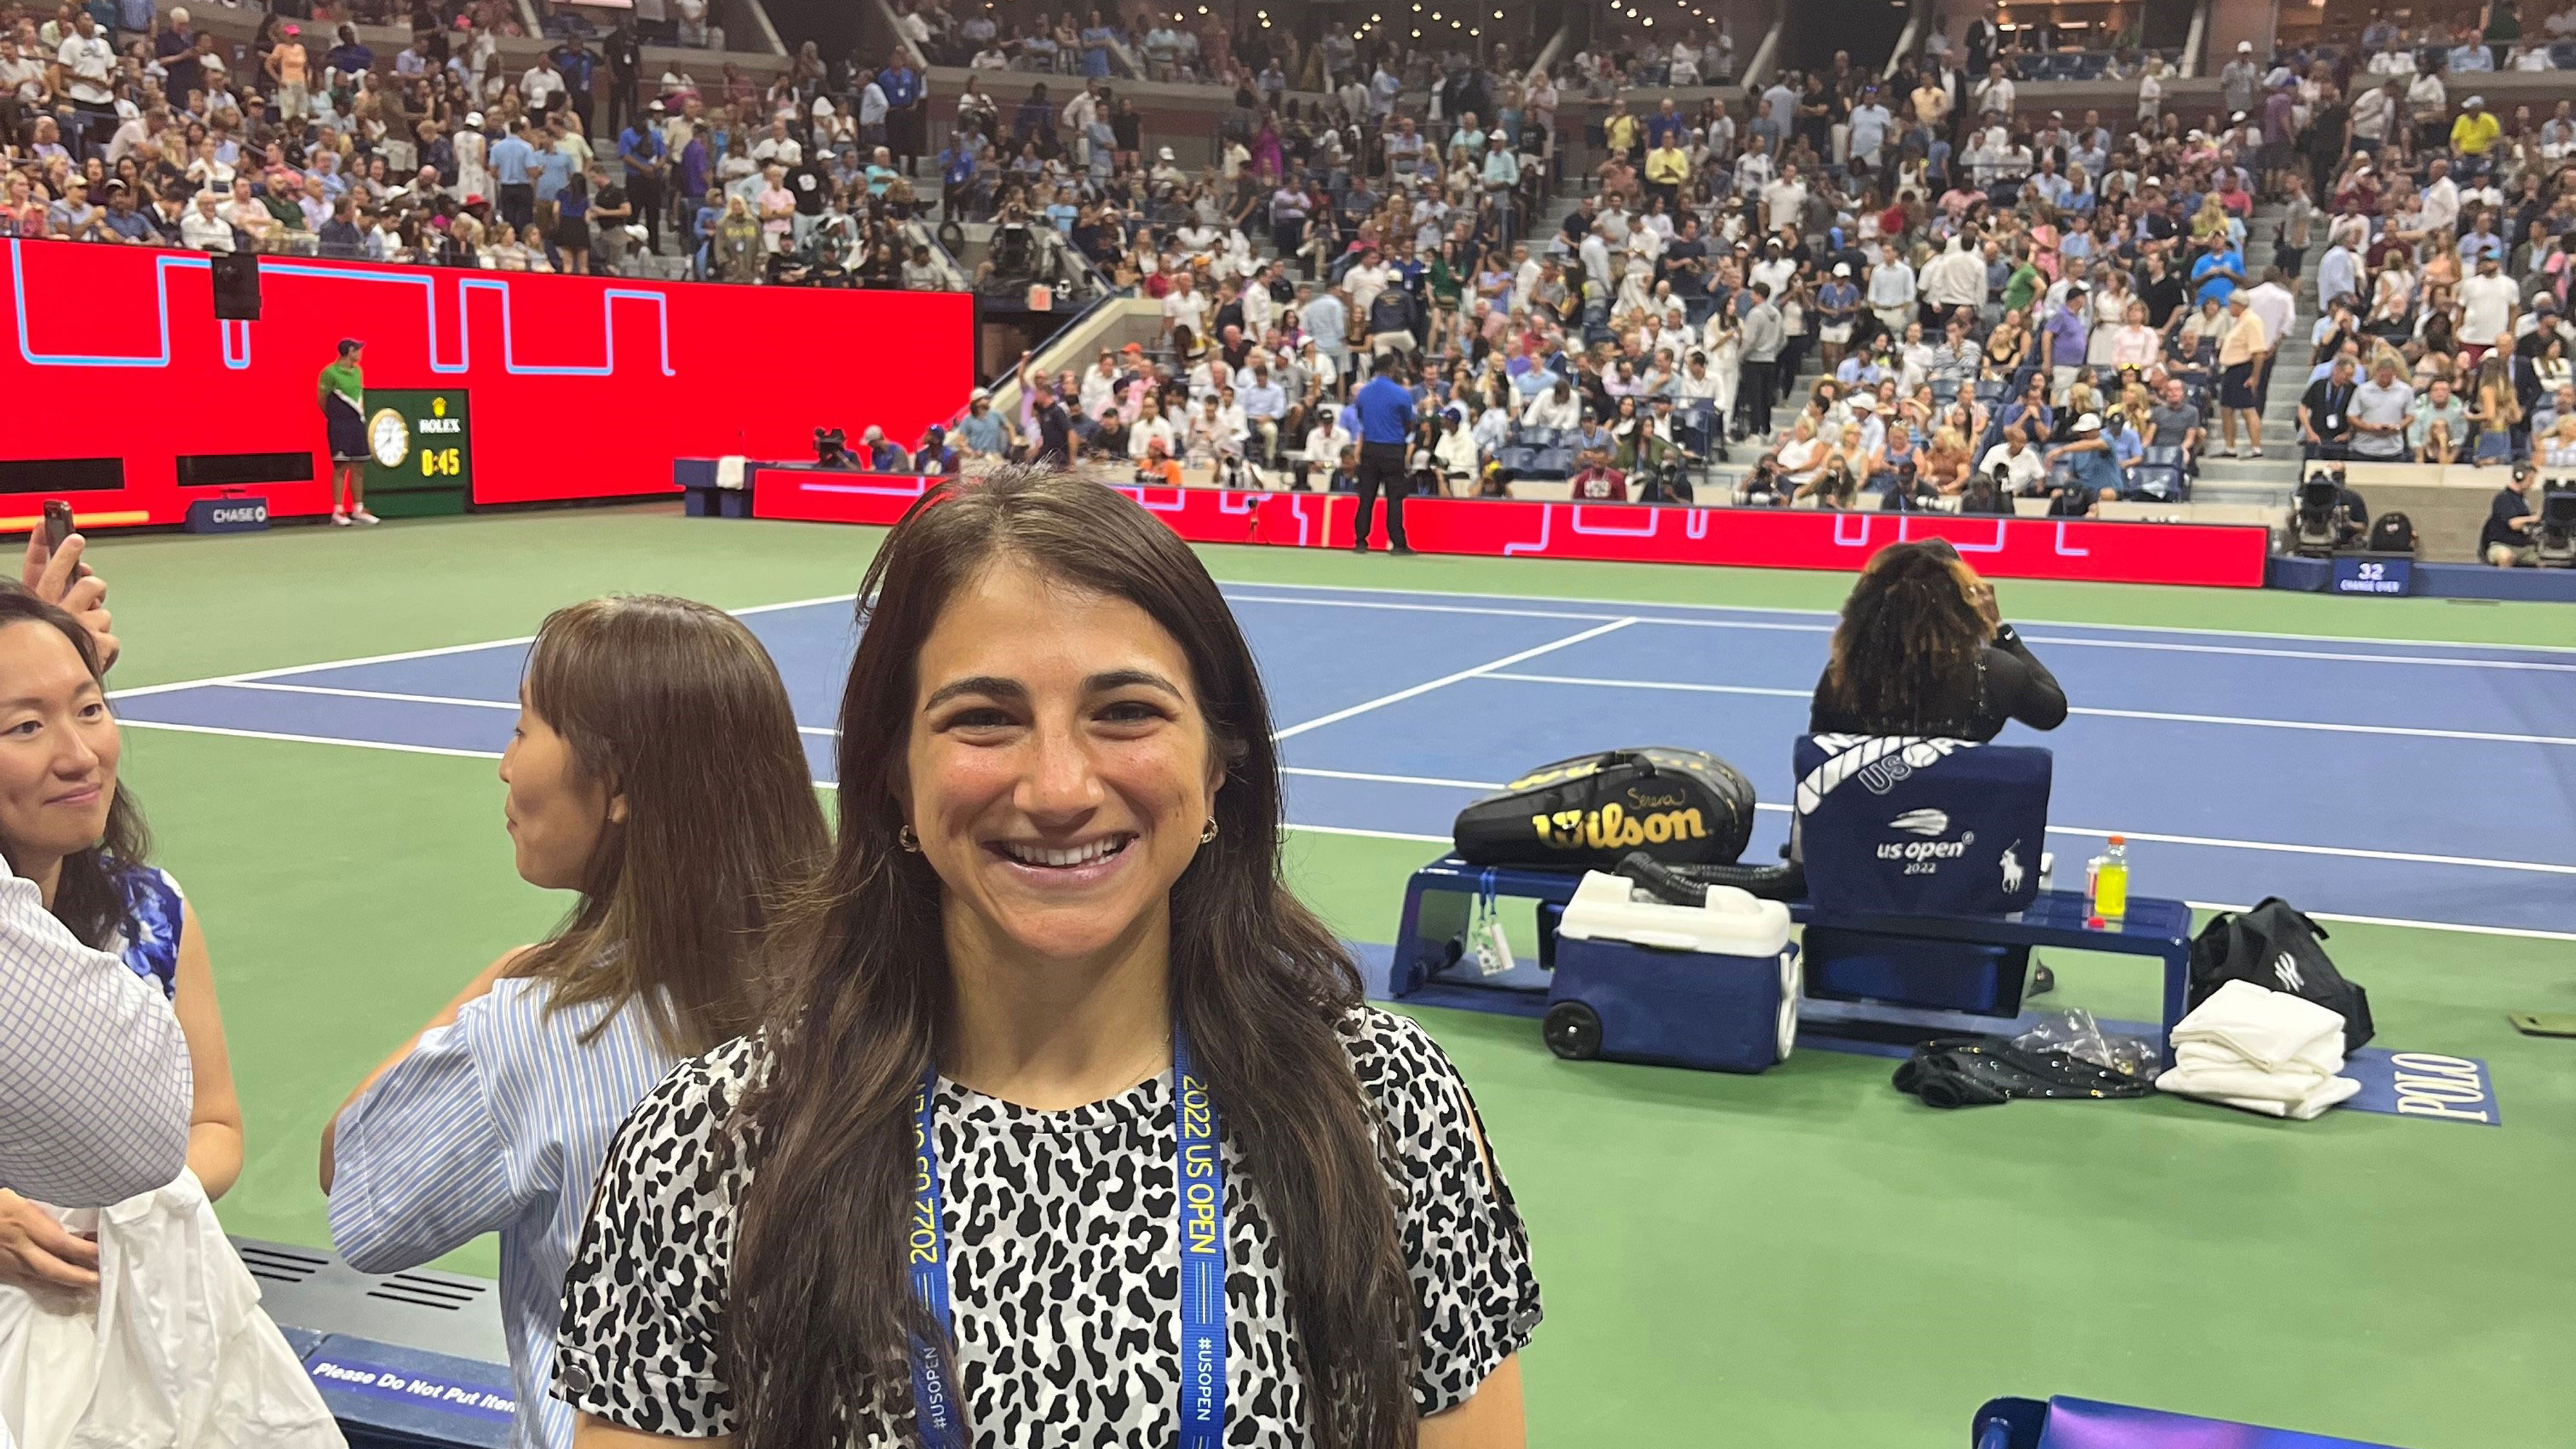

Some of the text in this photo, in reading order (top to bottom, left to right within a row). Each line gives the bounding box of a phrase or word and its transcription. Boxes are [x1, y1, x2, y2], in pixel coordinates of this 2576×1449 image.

[419, 418, 461, 434] ROLEX
[421, 448, 460, 477] 0:45
[213, 507, 254, 523] CHASE
[2358, 562, 2384, 580] 32
[1627, 787, 1687, 810] Serena
[1531, 802, 1707, 850] Wilson
[1877, 843, 1902, 859] us
[1903, 862, 1937, 875] 2022
[2390, 1052, 2488, 1123] POLO
[1182, 1074, 1217, 1255] 2022 US OPEN
[909, 1197, 938, 1264] 2022
[312, 1362, 376, 1385] Please
[376, 1373, 406, 1390] Do
[406, 1379, 444, 1399] Not
[442, 1387, 480, 1406] Put
[923, 1346, 947, 1430] #USOPEN
[1197, 1336, 1213, 1422] #USOPEN
